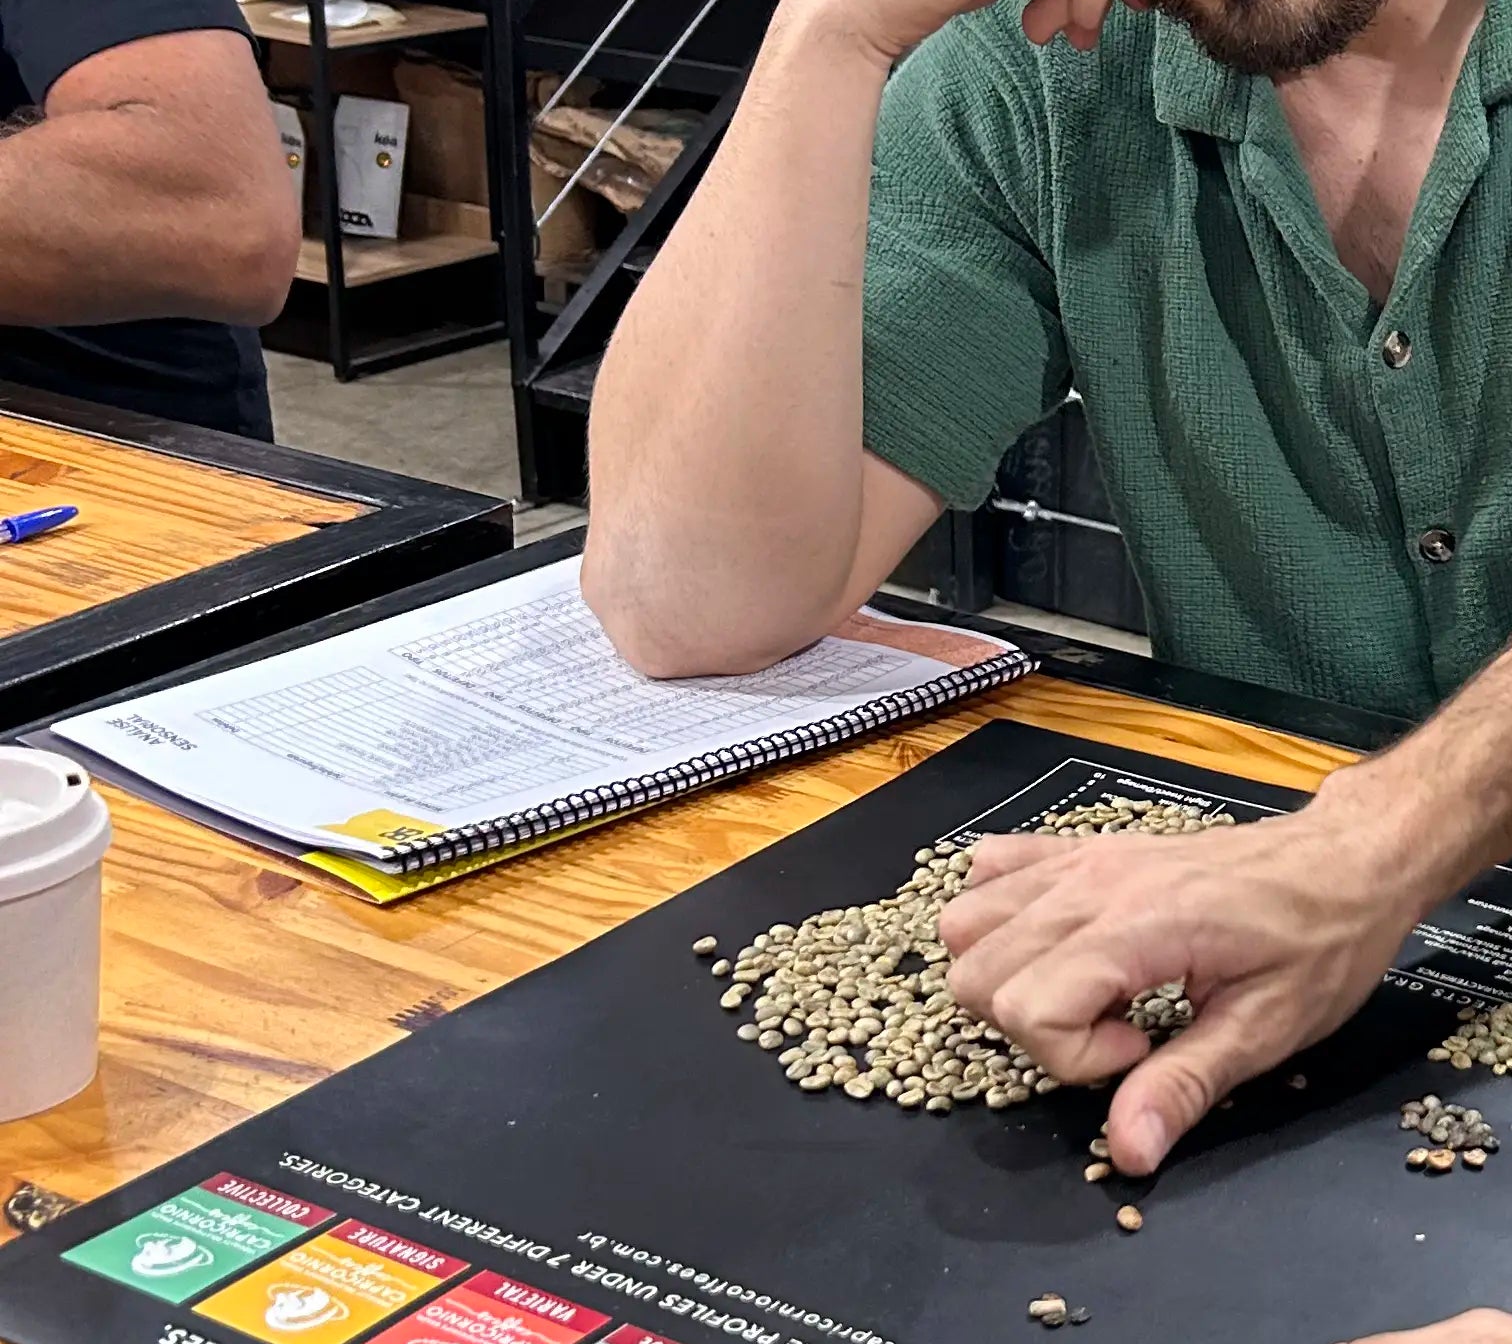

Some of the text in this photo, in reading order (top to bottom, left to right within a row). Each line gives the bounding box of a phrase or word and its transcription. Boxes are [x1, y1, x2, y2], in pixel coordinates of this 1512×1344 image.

[217, 1179, 311, 1220] COLLECTIVE
[278, 1151, 421, 1212] CATEGORIES.
[158, 1203, 273, 1250] CAPRICORNIO
[418, 1203, 552, 1263] DIFFERENT
[349, 1227, 447, 1271] SIGNATURE
[546, 1251, 572, 1269] 7
[291, 1251, 408, 1303] CAPRICORNIO
[570, 1259, 660, 1303] UNDER
[493, 1280, 579, 1322] VARIETAL
